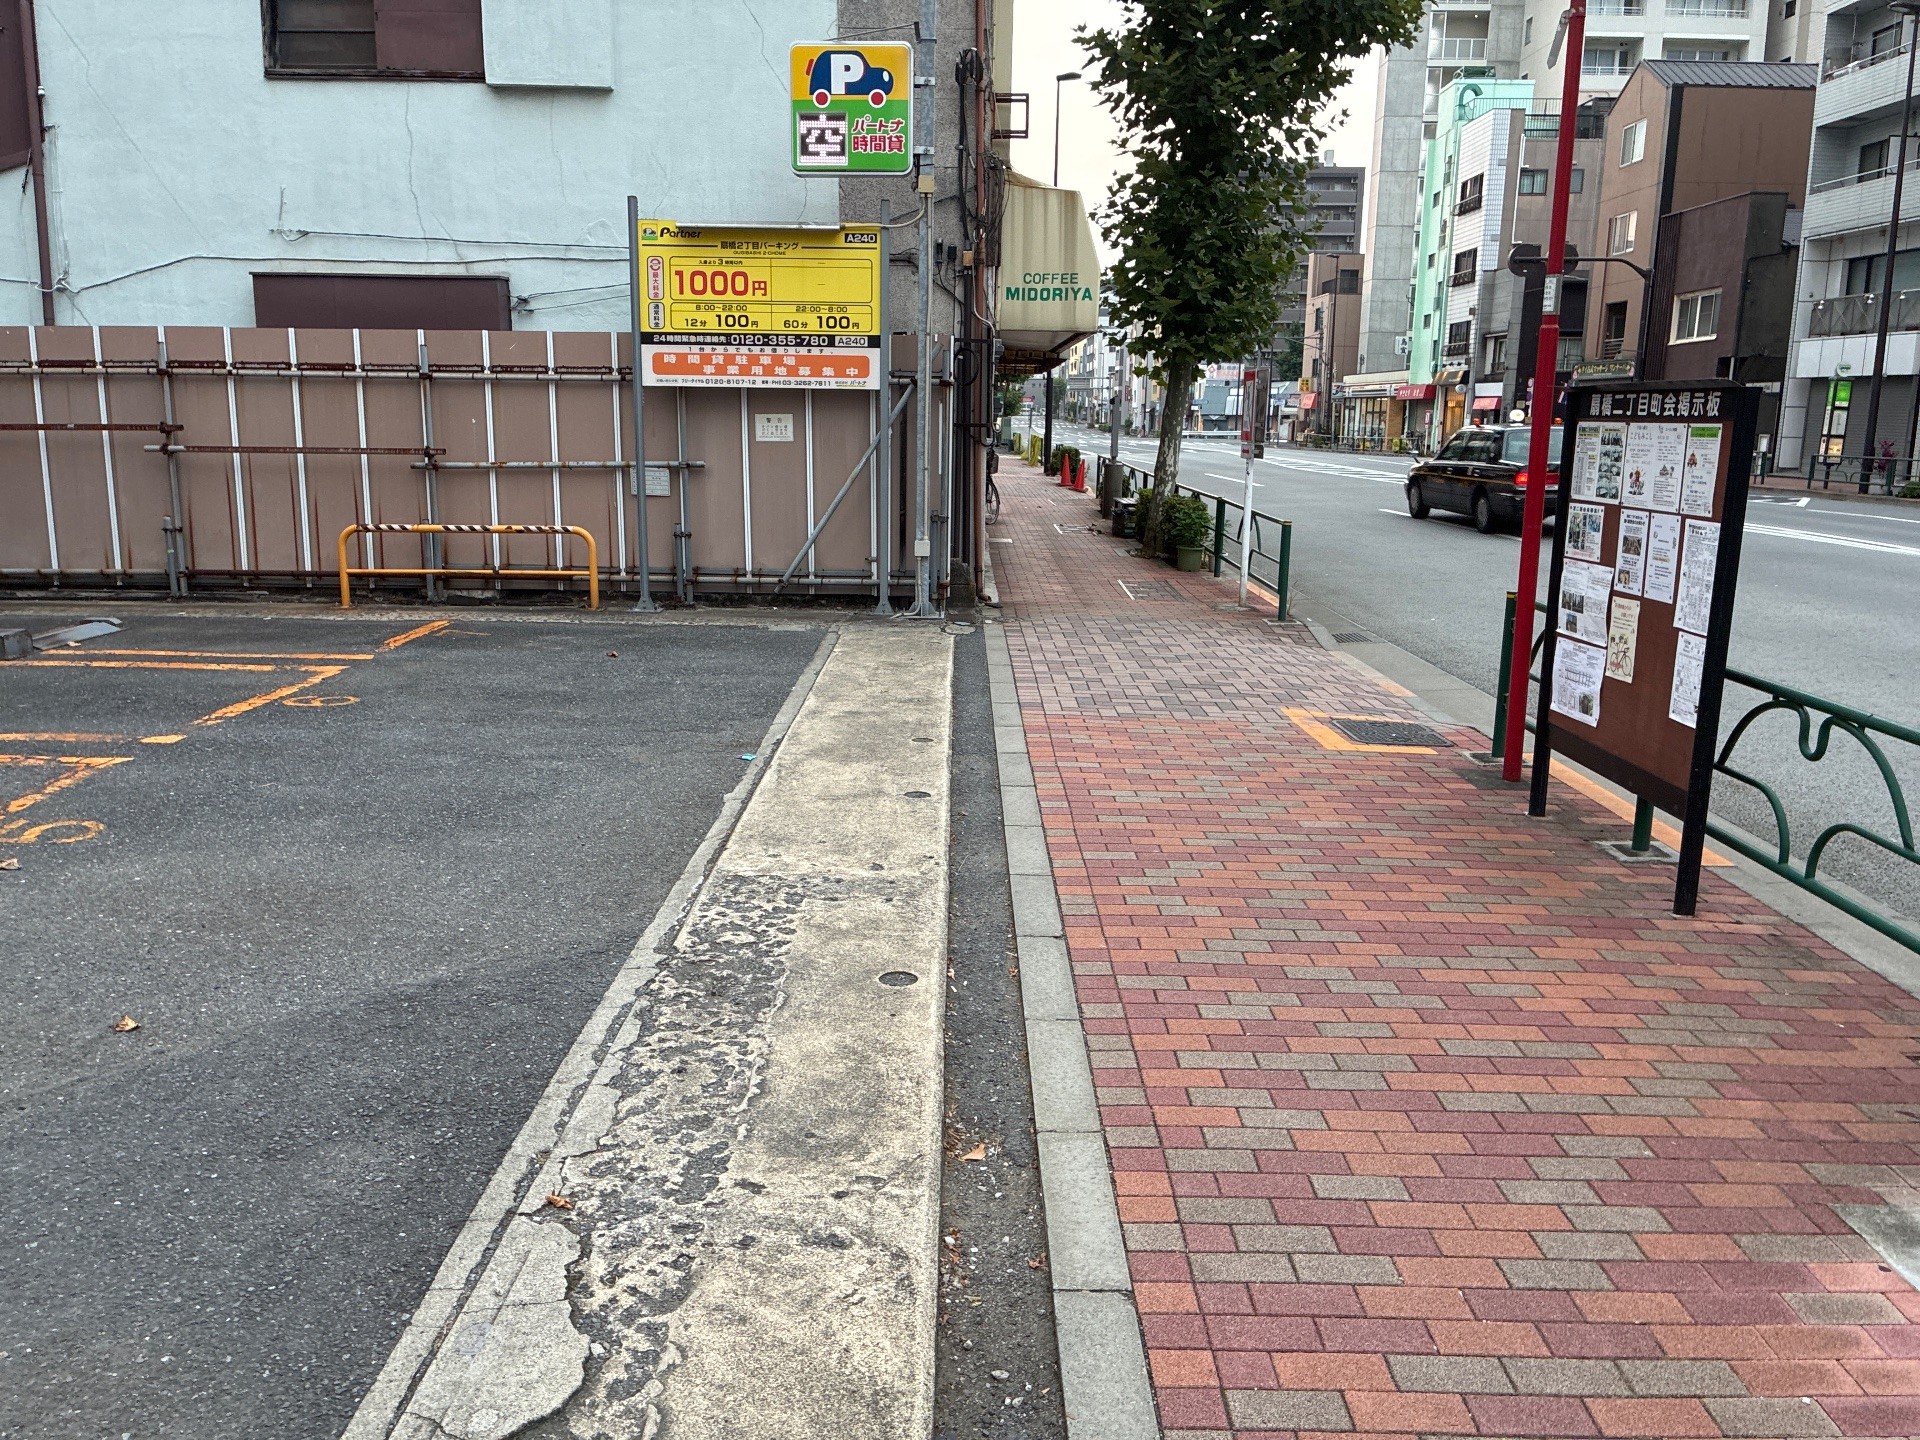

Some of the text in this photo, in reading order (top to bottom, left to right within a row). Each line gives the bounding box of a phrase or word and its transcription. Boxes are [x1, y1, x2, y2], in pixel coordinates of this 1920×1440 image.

[830, 53, 865, 94] P
[852, 115, 904, 133] パートナ
[799, 114, 846, 162] 空
[852, 134, 904, 153] 時間貸
[660, 227, 702, 238] Partner
[846, 234, 876, 243] A240
[652, 272, 660, 298] 最大料金
[674, 269, 767, 297] 1000円
[1023, 272, 1079, 285] COFFEE
[1005, 286, 1093, 302] MIDORIYA
[684, 313, 759, 328] 12分 100円
[783, 315, 860, 330] 60分 100円
[837, 337, 866, 346] A240
[663, 353, 796, 366] 時間貸駐車場
[702, 364, 859, 377] 事業用地募集中
[1590, 391, 1722, 417] 扇橋二丁目町会掲示板
